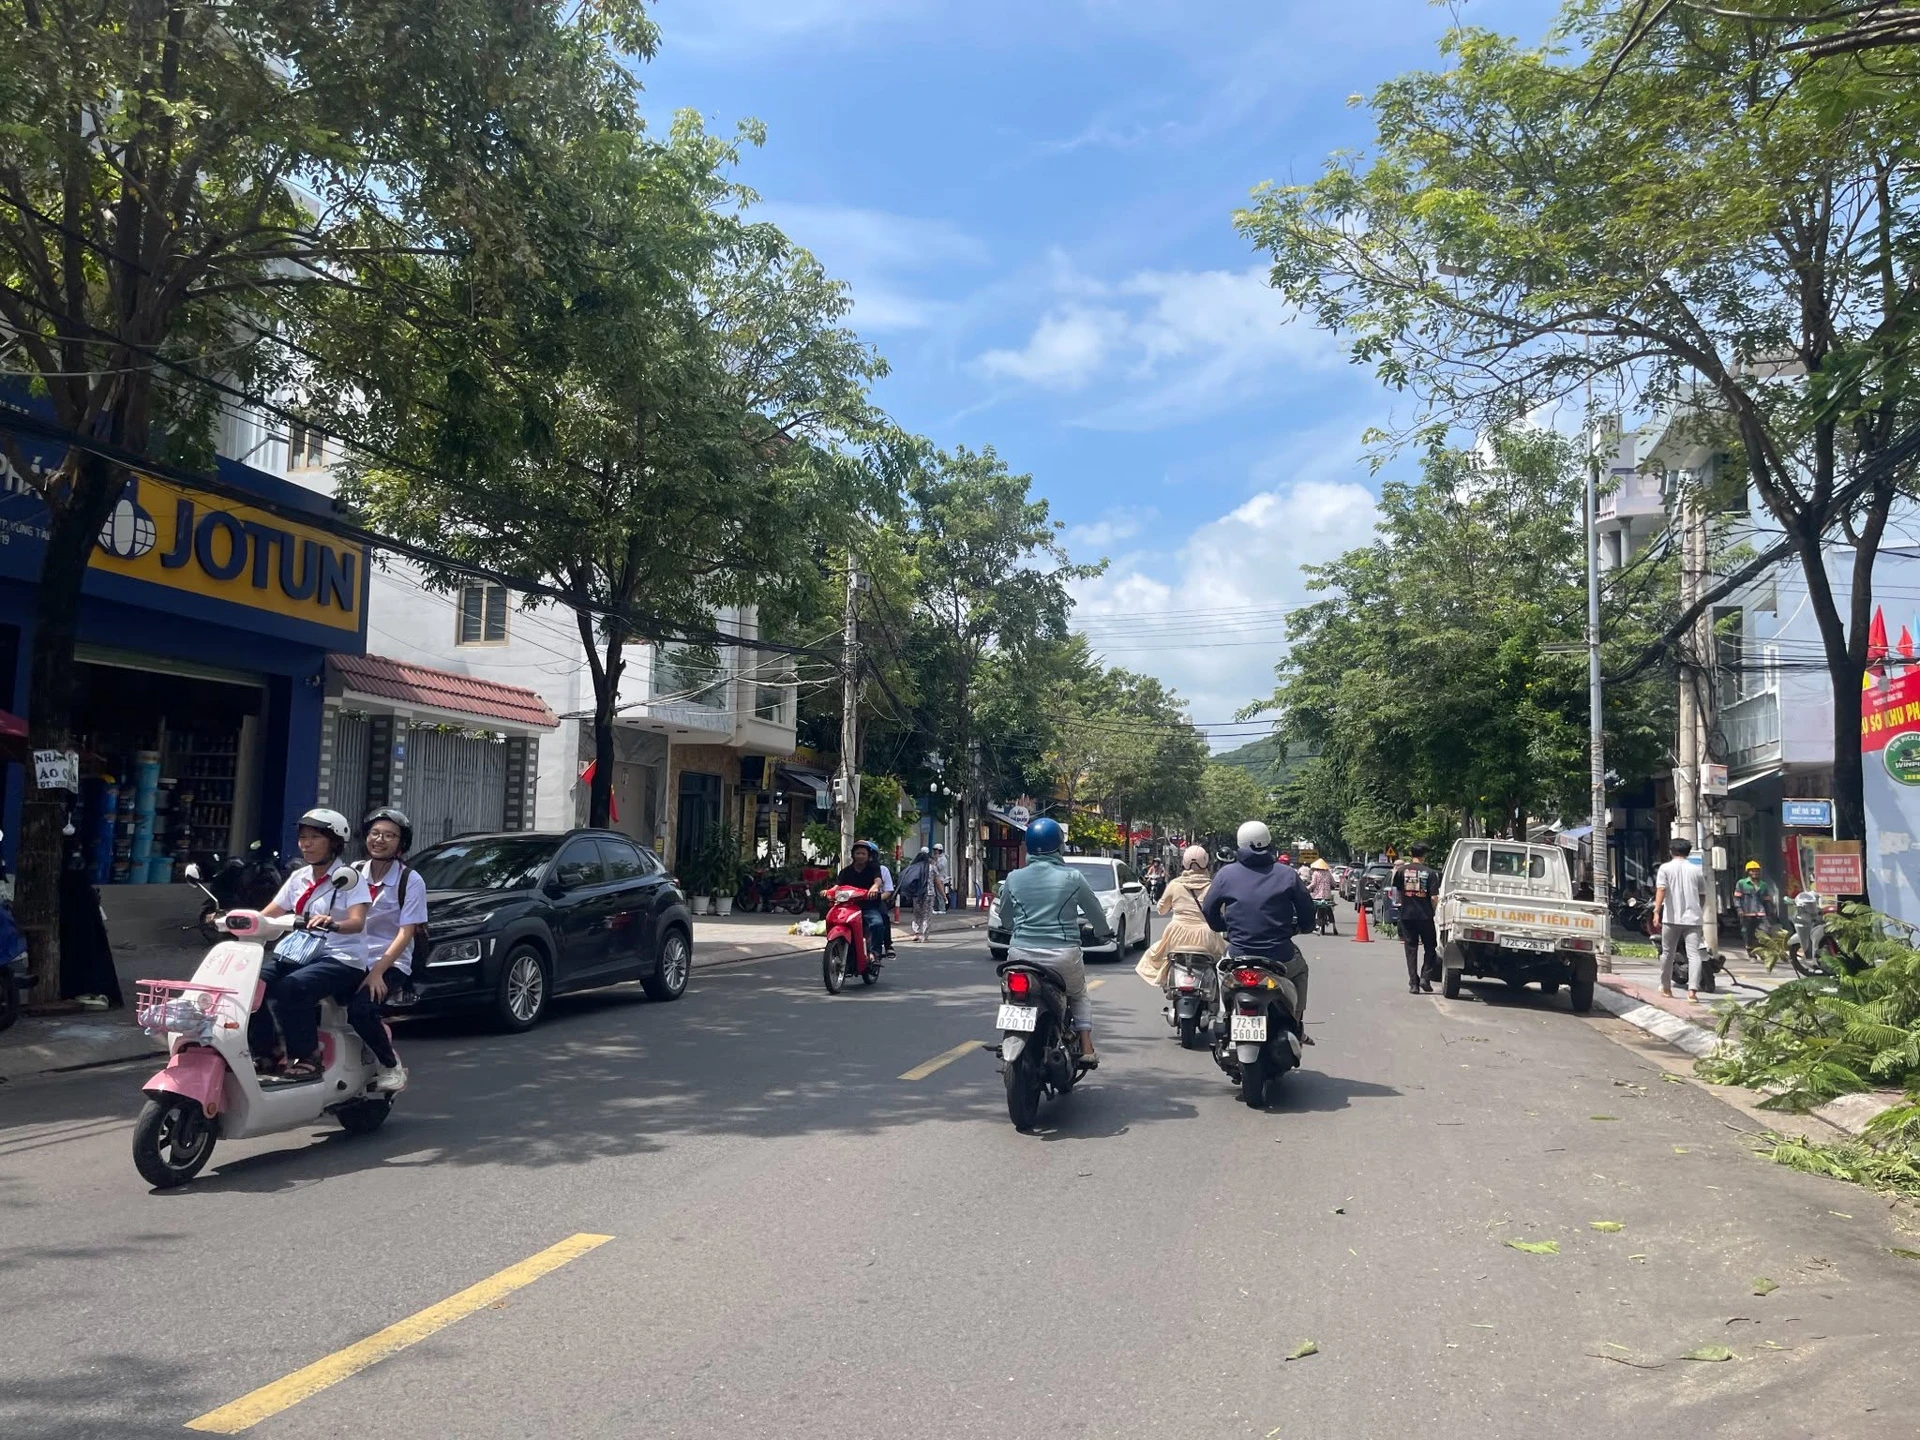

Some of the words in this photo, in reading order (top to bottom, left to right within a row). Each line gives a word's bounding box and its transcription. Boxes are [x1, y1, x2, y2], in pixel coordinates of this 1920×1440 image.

[160, 499, 356, 613] JOTUN
[1905, 700, 1920, 723] PH
[1505, 937, 1551, 950] 72C-226.61
[1004, 1006, 1033, 1019] 72-C2
[998, 1017, 1035, 1030] 020.10
[1236, 1017, 1261, 1029] 72-C1
[1232, 1029, 1266, 1040] 560.06
